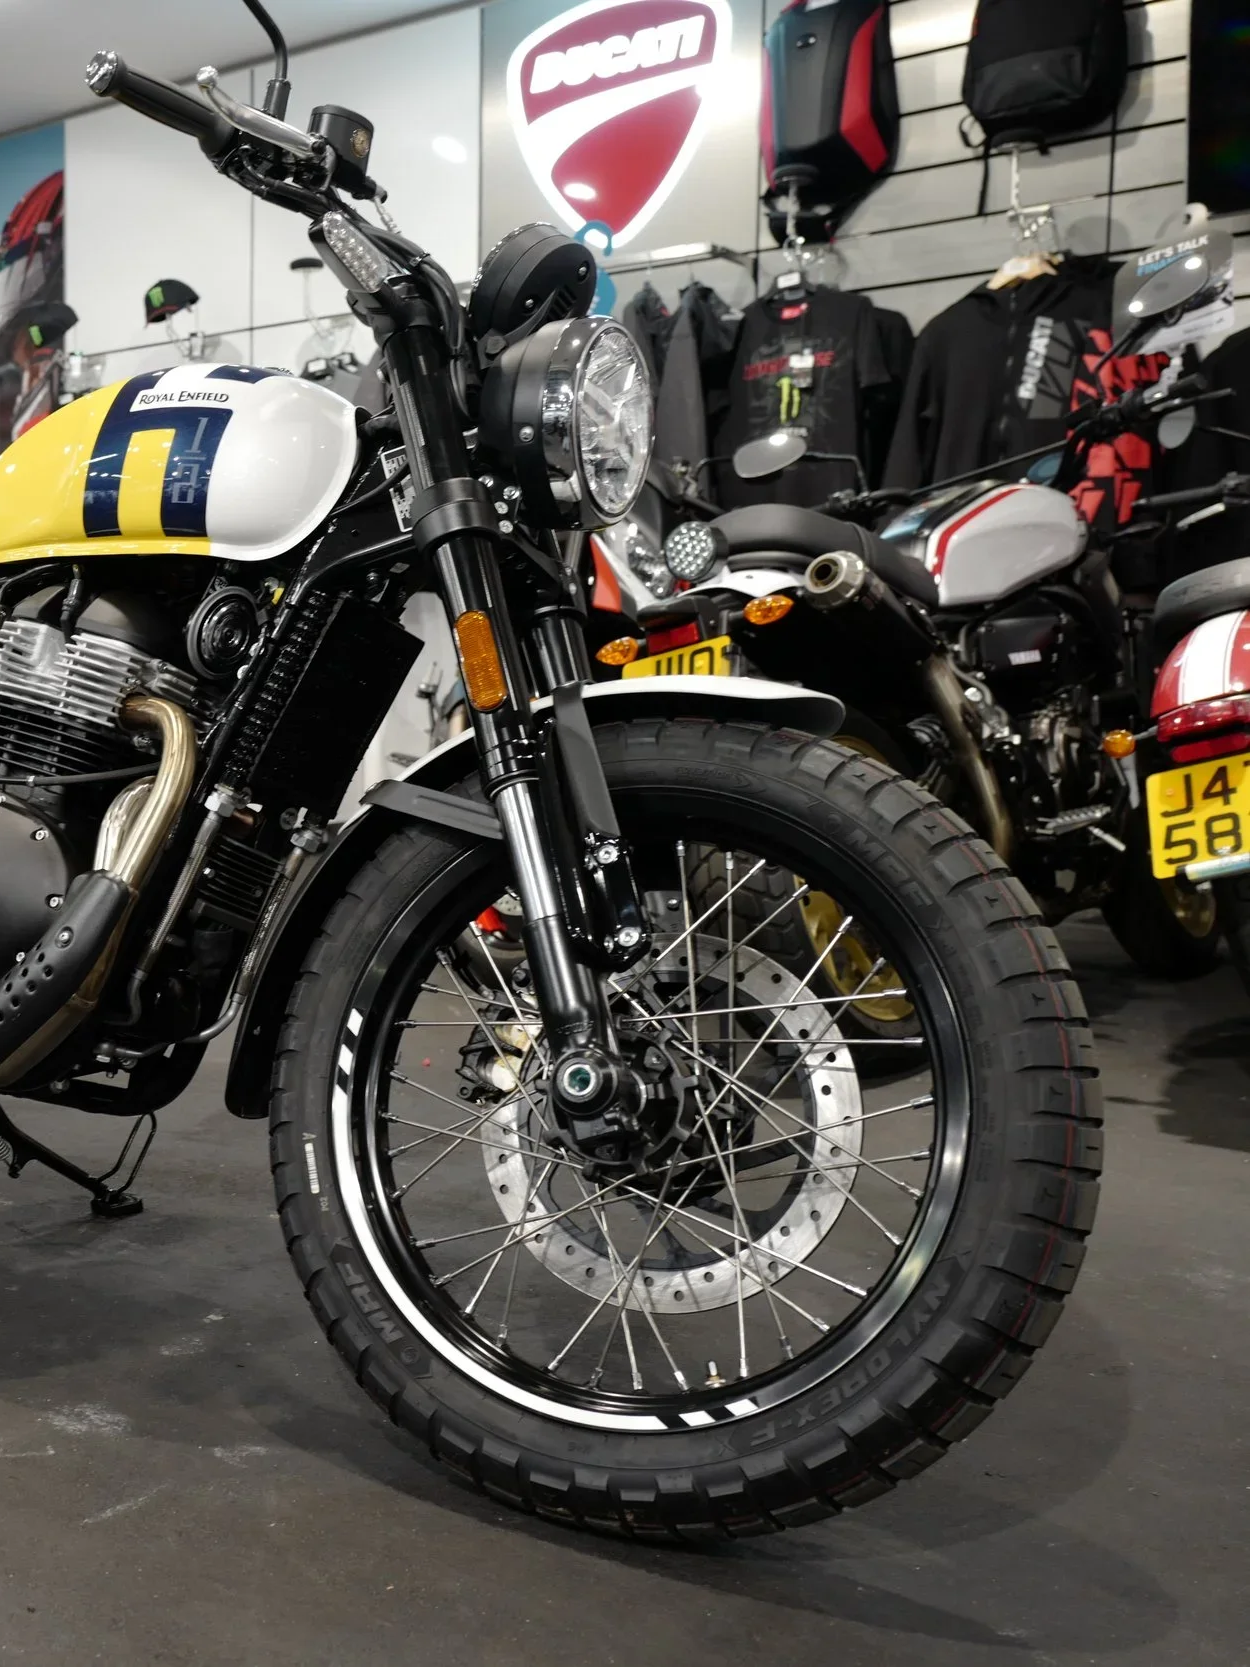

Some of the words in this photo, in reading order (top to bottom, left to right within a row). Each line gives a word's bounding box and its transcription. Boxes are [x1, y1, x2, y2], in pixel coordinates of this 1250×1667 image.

[529, 14, 706, 94] DUCATI
[1137, 246, 1174, 266] LET'S
[1177, 235, 1209, 253] TALK
[1017, 315, 1054, 400] DUCATI
[139, 393, 175, 405] ROYAL
[178, 391, 230, 403] ENFIELD
[1160, 760, 1250, 818] J4
[844, 828, 934, 907] MRF
[336, 1262, 405, 1344] MRF
